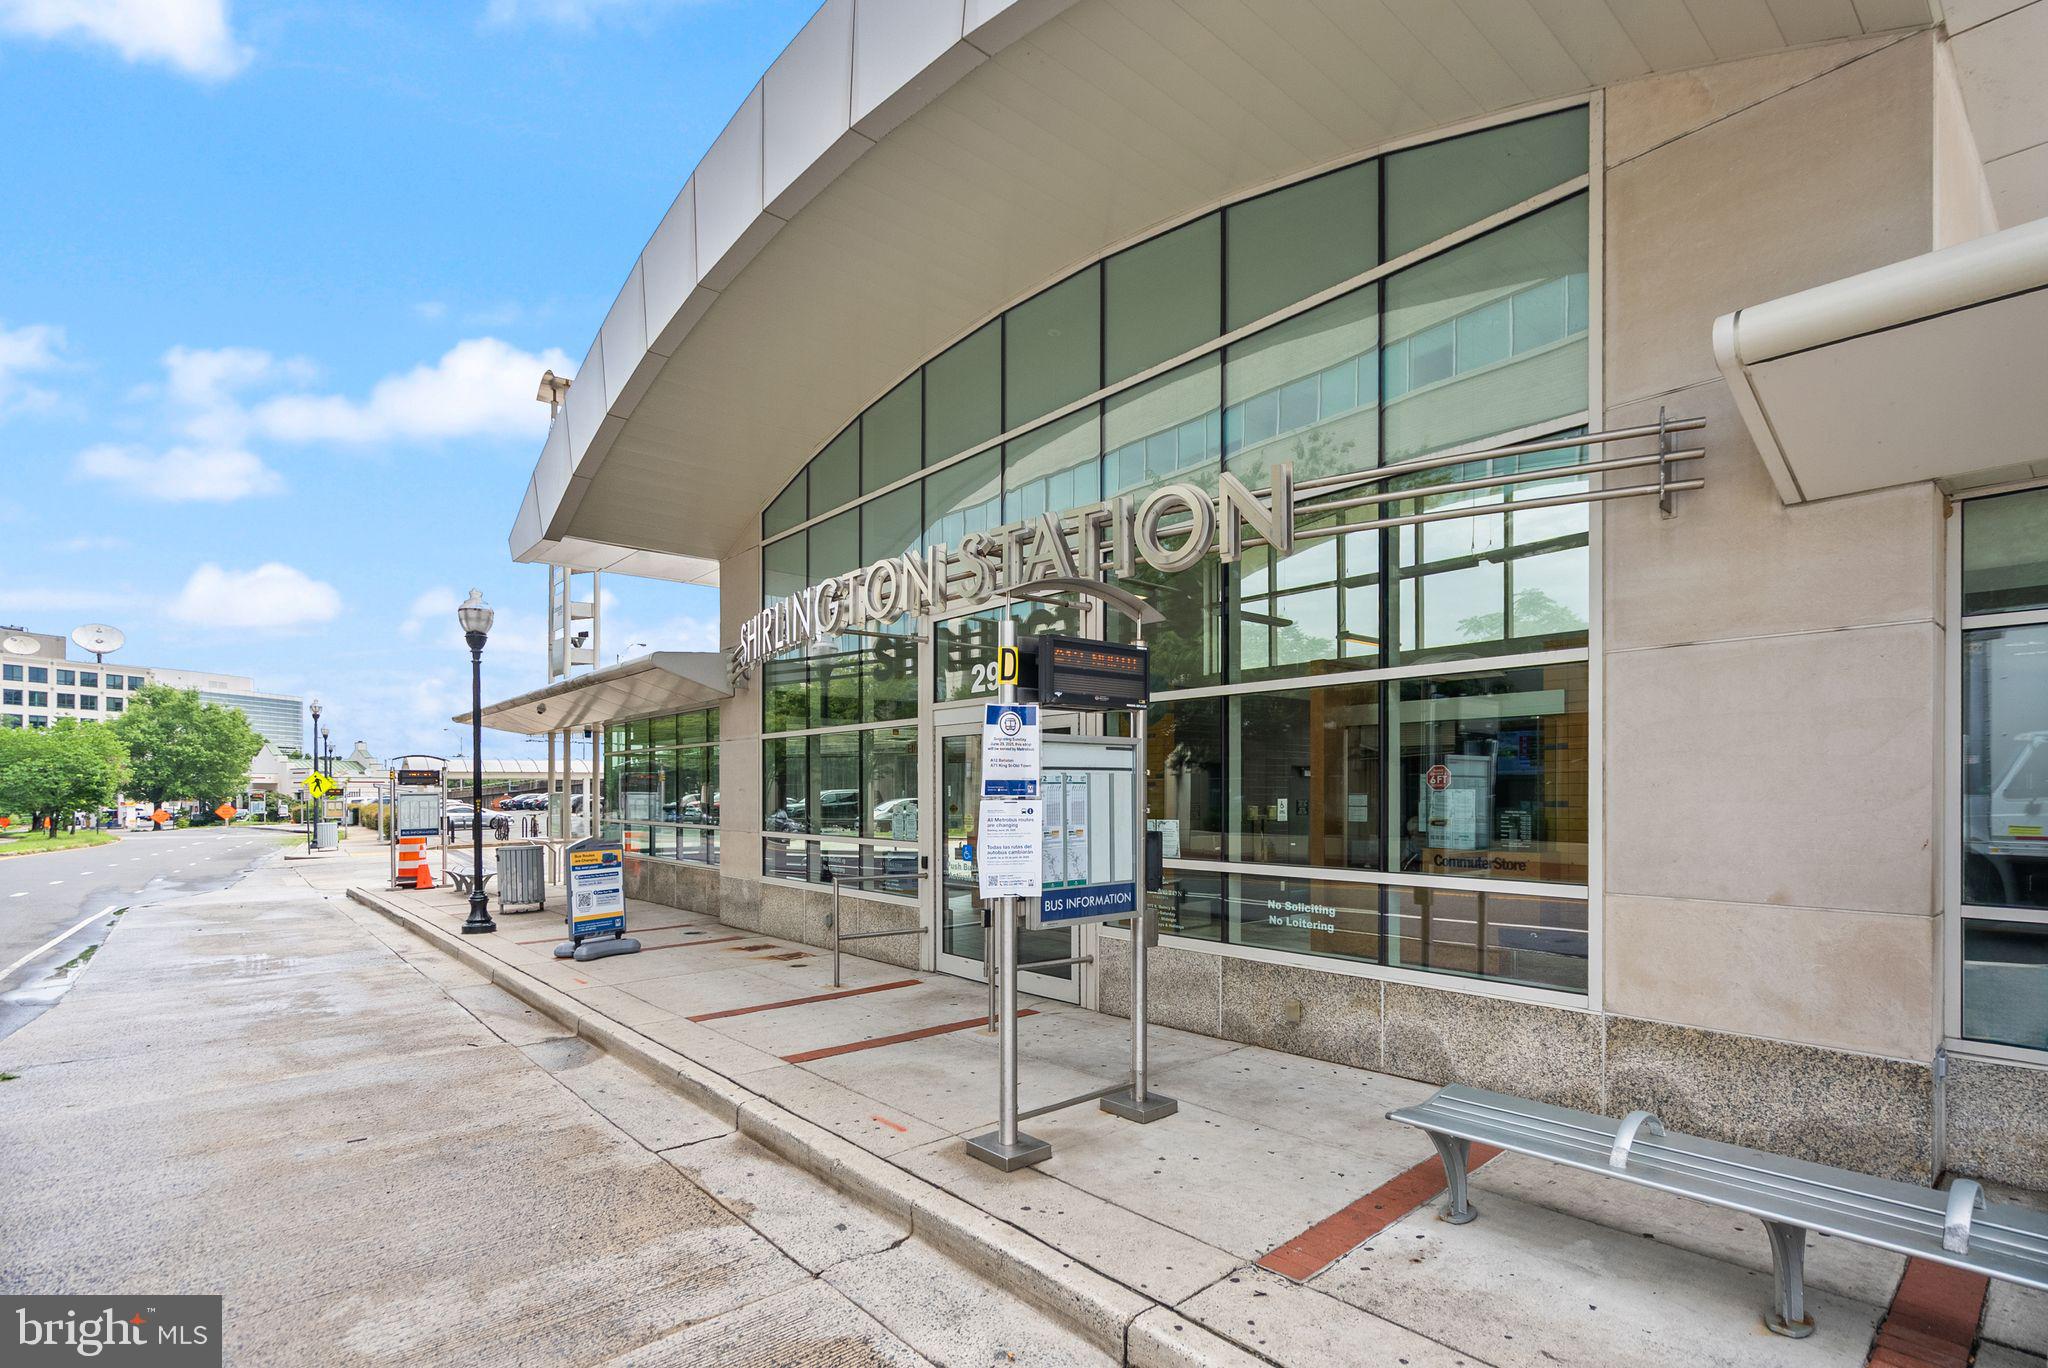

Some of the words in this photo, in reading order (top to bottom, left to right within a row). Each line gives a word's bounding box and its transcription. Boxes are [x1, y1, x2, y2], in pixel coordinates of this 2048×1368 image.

[740, 543, 948, 665] SHIRLINGTON
[959, 462, 1294, 605] STATION
[1001, 648, 1016, 680] D
[1045, 899, 1063, 911] BUS
[1066, 892, 1131, 909] INFORMATION
[1268, 900, 1281, 909] No
[1285, 901, 1336, 917] Soliciting
[1269, 915, 1282, 925] No
[1286, 917, 1334, 933] Loitering
